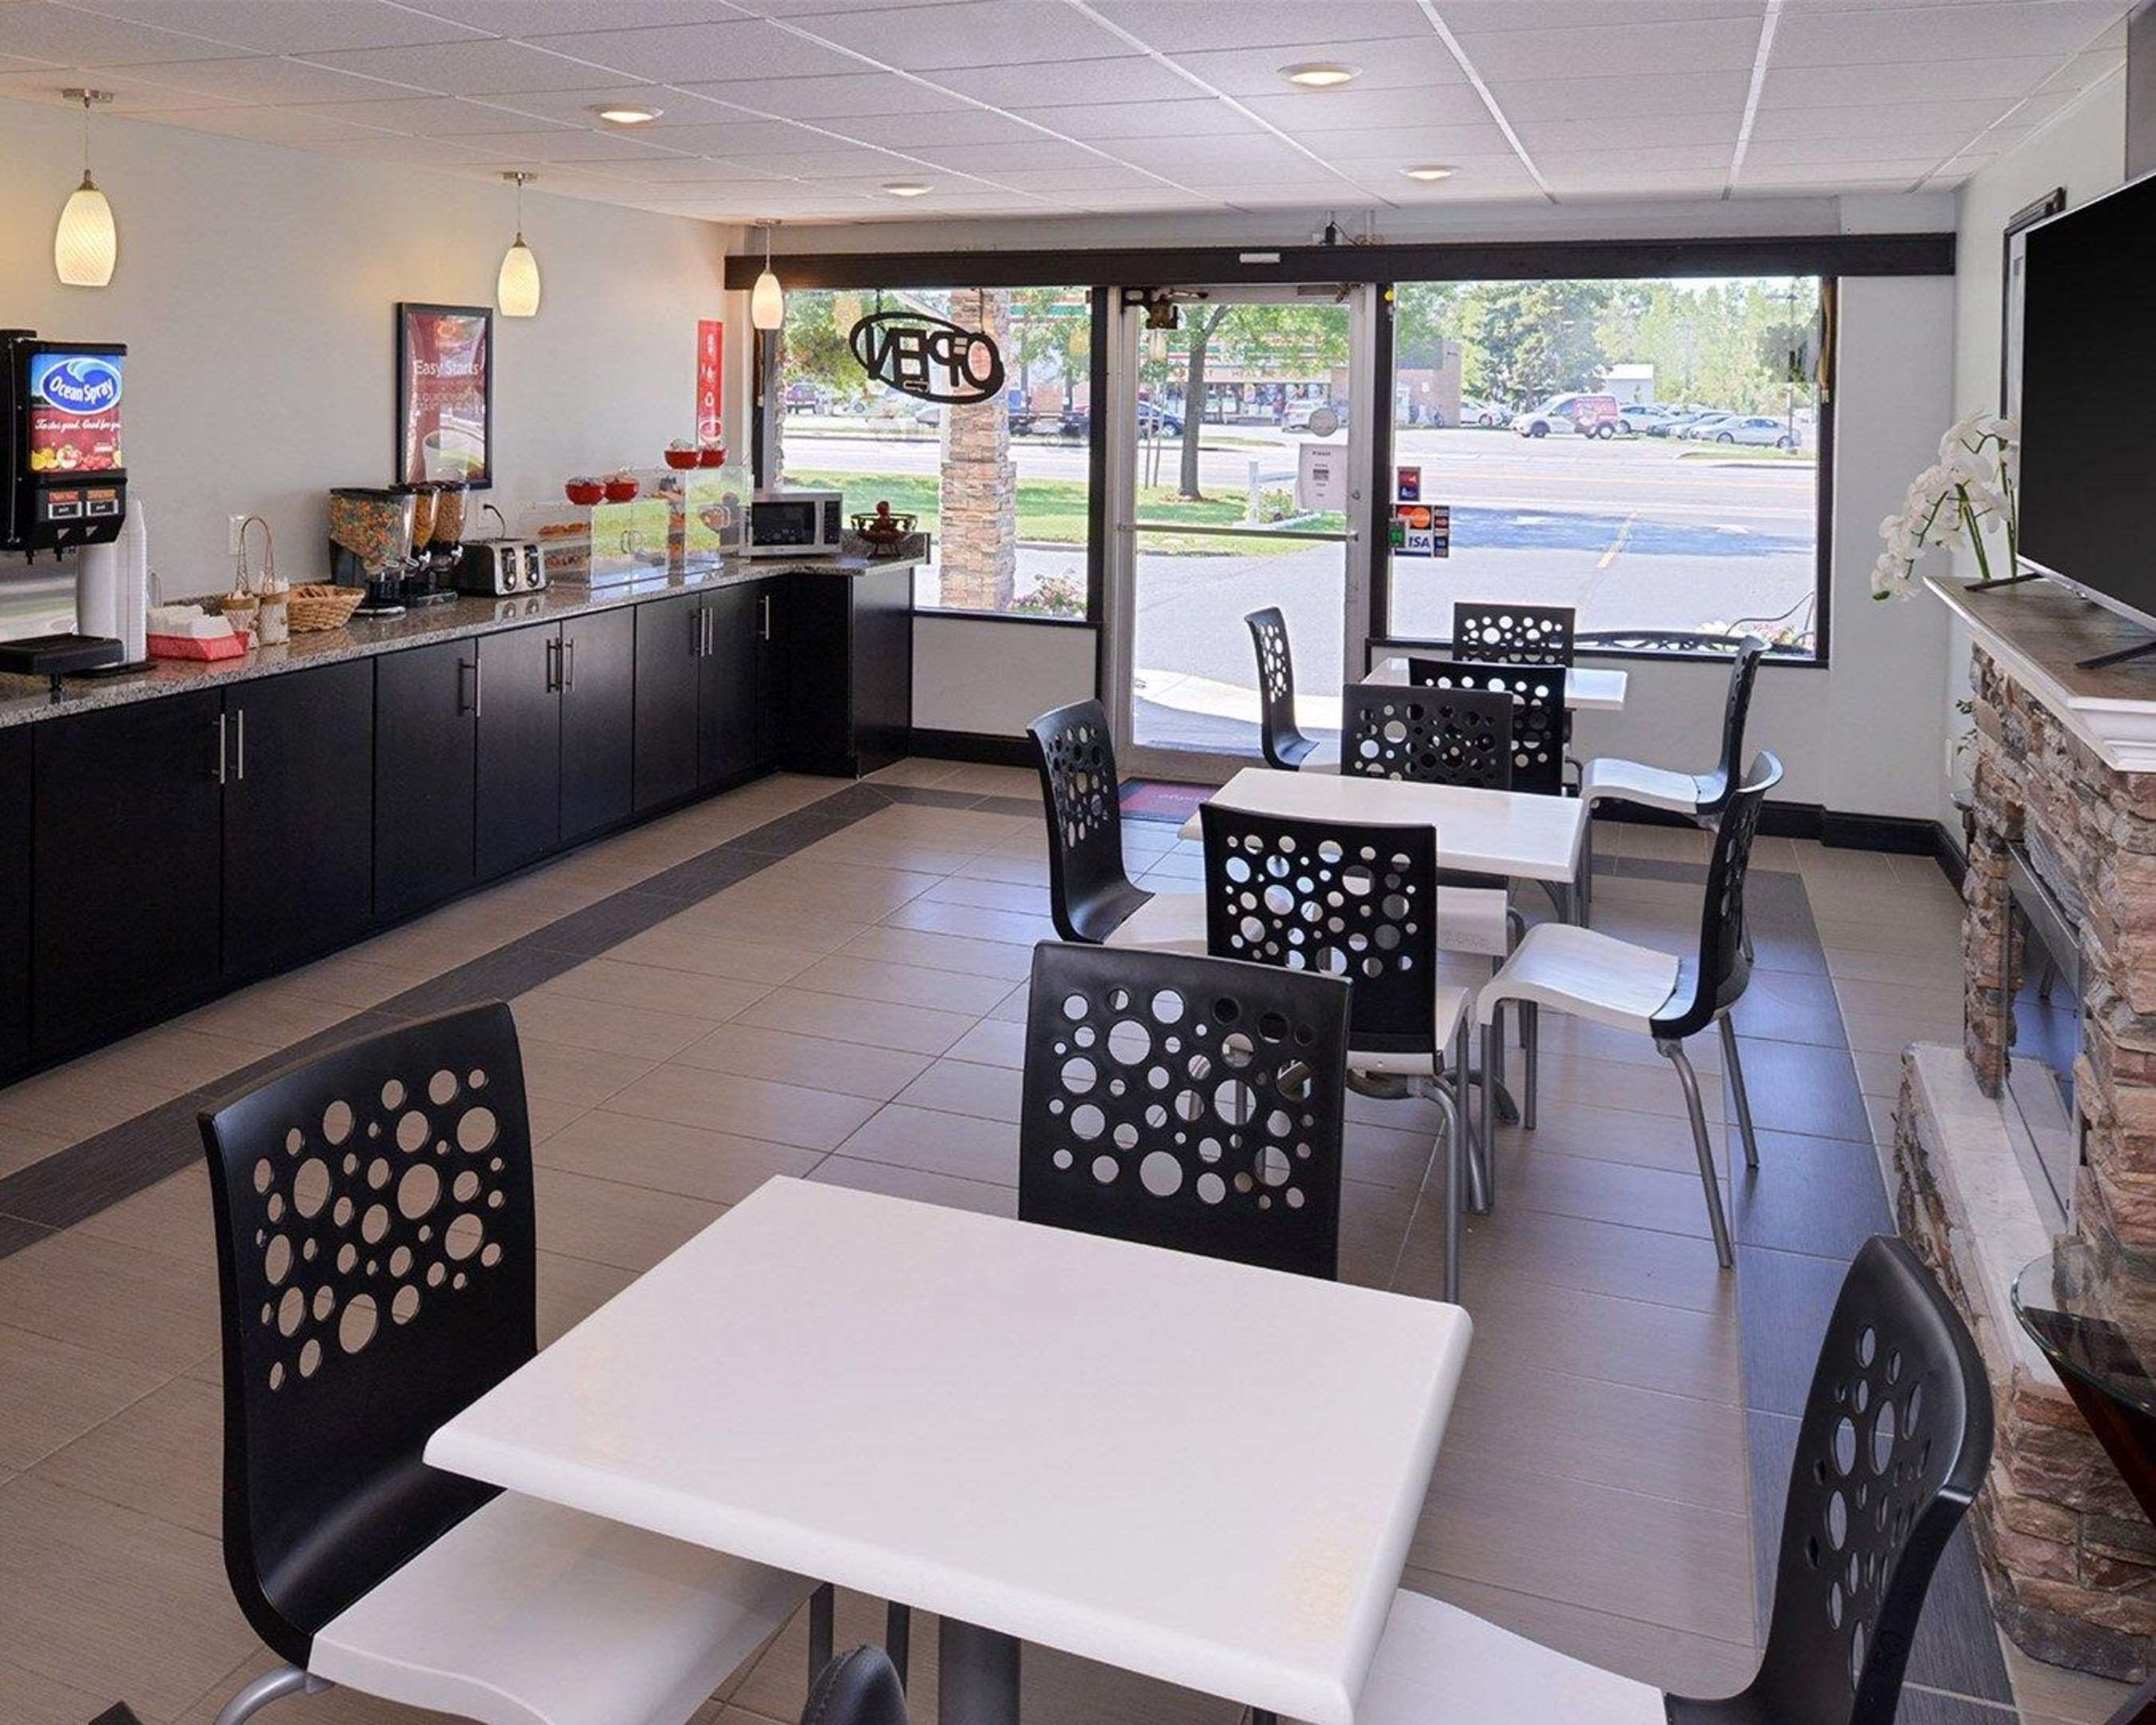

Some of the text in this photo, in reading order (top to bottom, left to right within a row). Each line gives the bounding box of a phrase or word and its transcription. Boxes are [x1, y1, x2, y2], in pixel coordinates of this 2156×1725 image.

[416, 359, 480, 378] Easy Starts
[49, 376, 114, 404] Ocean Spray
[1408, 535, 1431, 548] ISA
